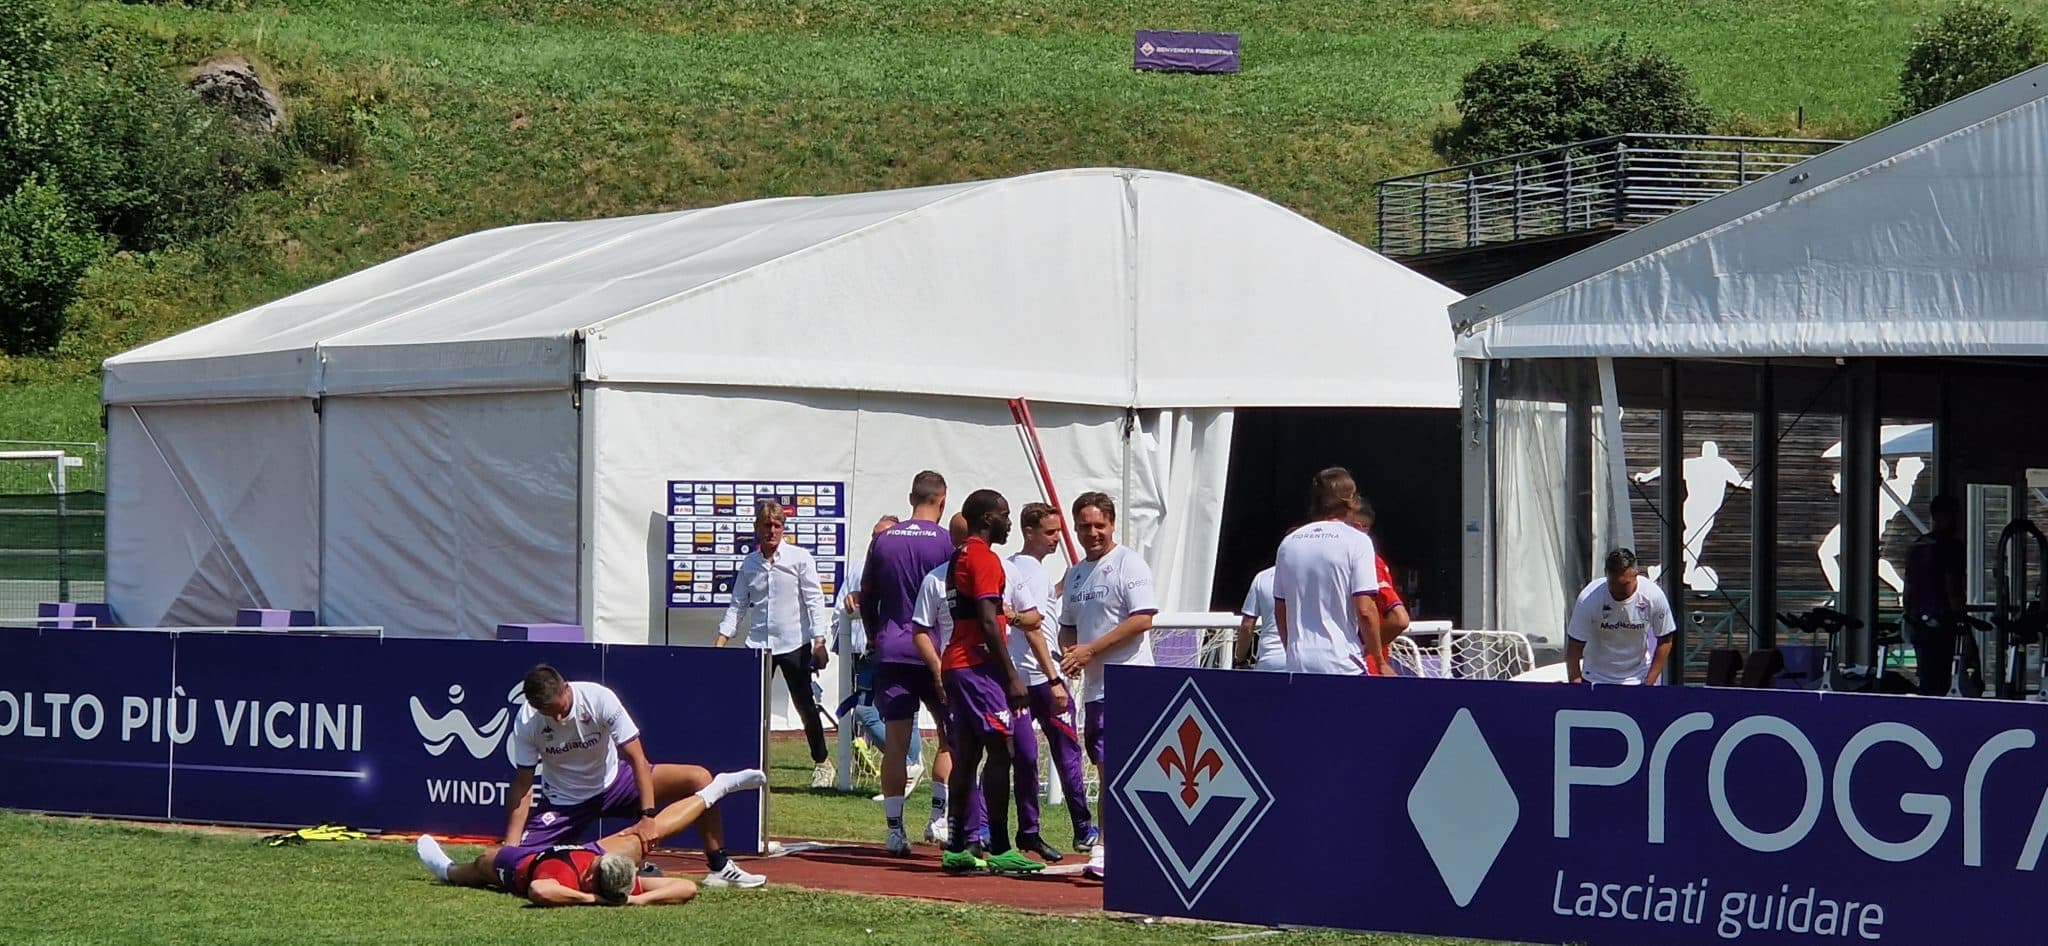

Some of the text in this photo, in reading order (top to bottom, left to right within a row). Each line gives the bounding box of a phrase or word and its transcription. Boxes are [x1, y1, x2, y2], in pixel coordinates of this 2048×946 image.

[886, 529, 937, 537] FIORENTINA
[121, 685, 197, 744] PIÙ
[214, 699, 362, 751] VICINI
[426, 778, 542, 808] WINDTE
[1552, 870, 1885, 940] Lasciati guidare
